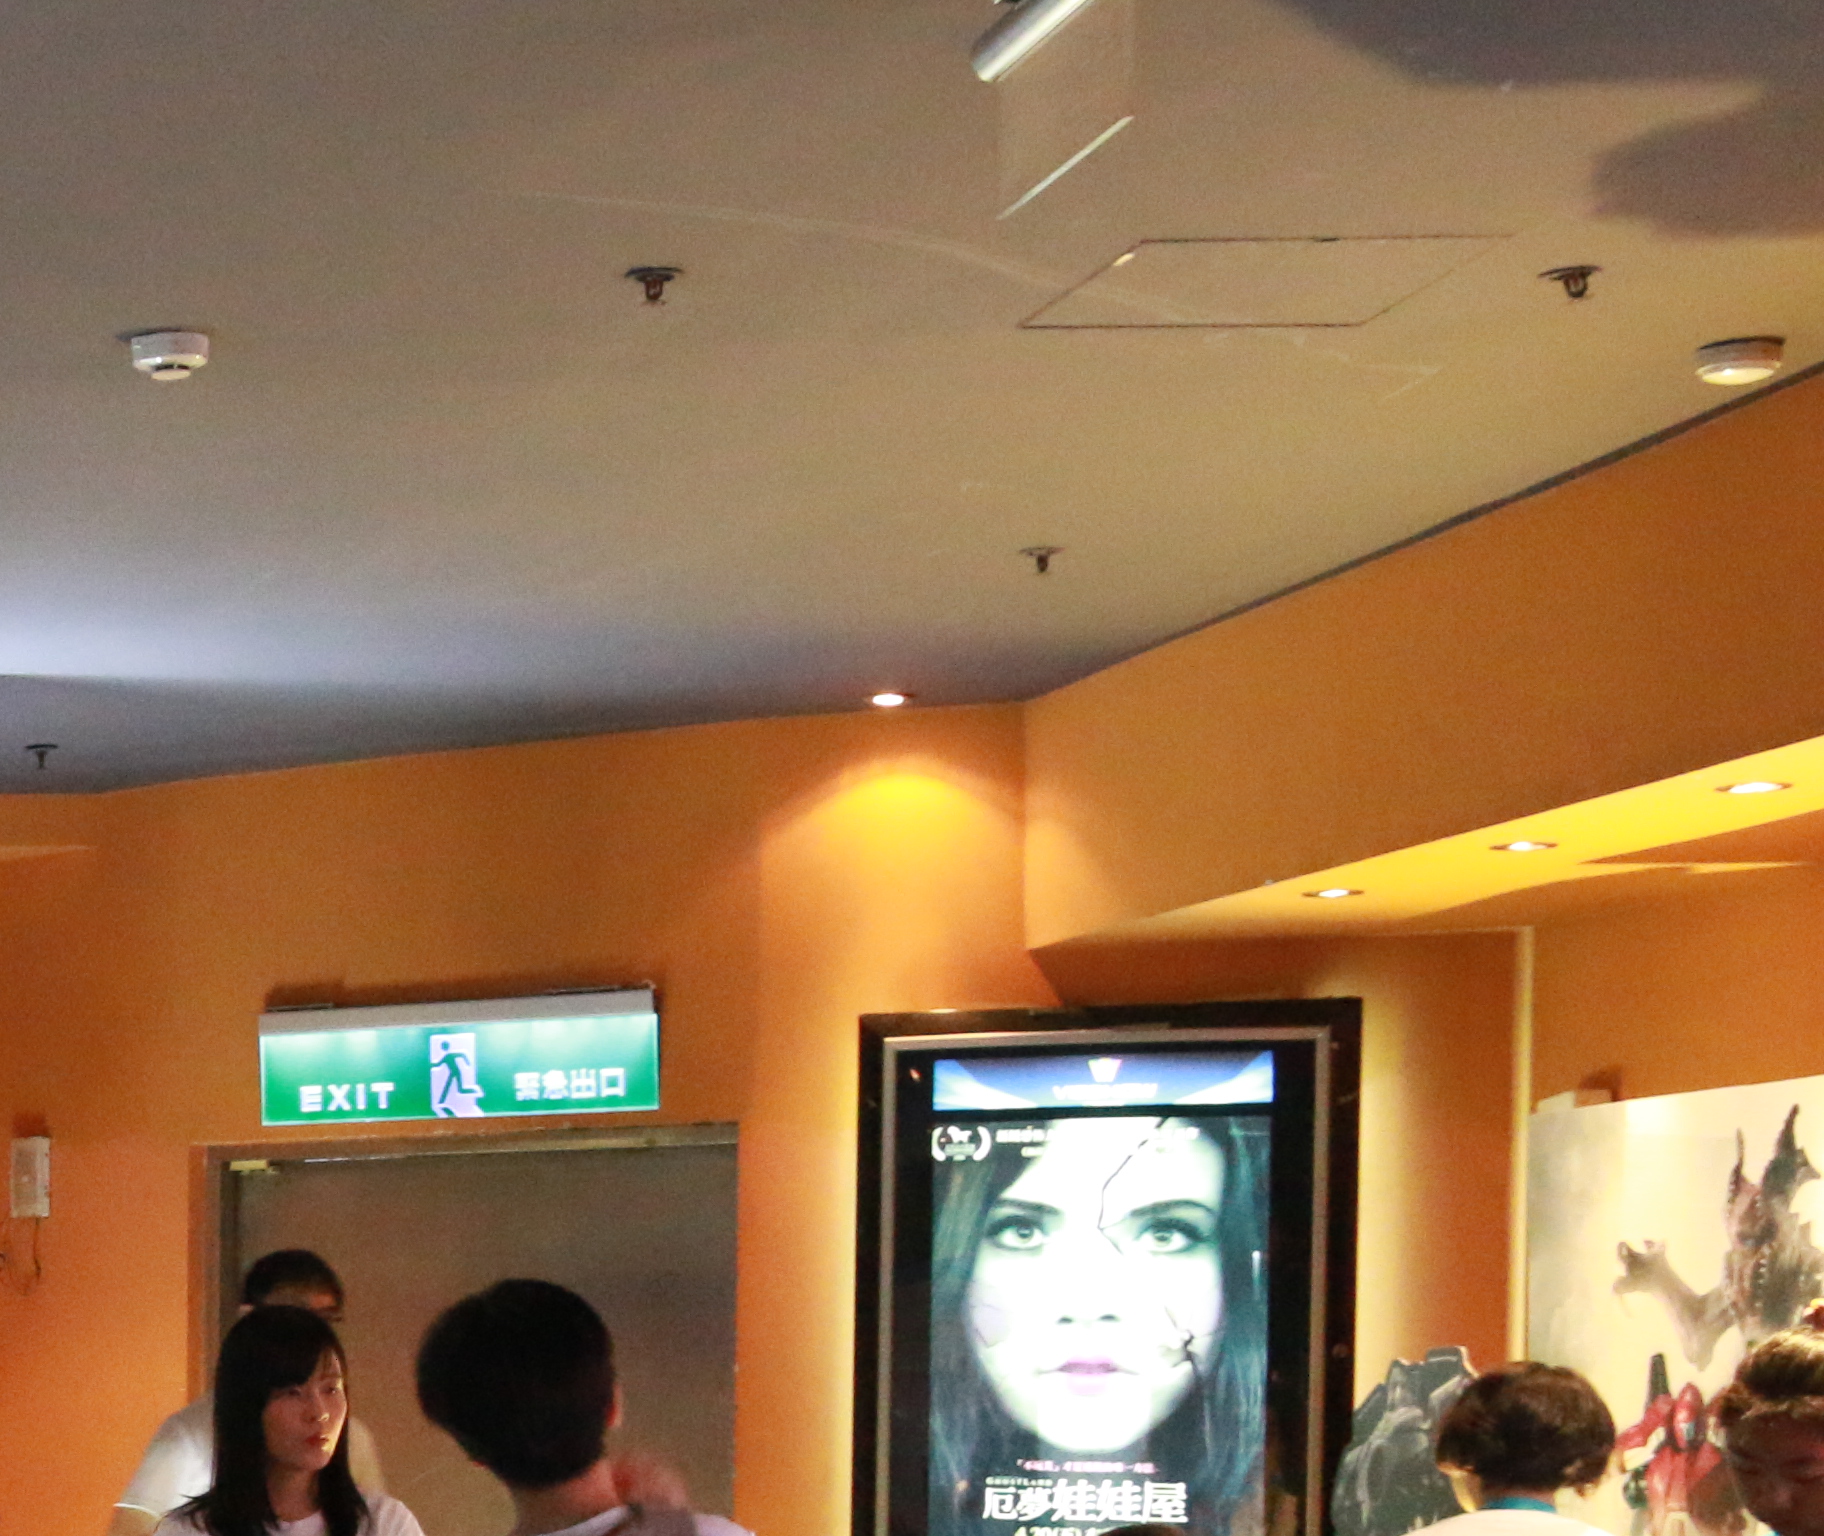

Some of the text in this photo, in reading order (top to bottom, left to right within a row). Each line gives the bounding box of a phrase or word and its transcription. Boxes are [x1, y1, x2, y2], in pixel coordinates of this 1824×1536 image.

[299, 1082, 395, 1112] EXIT
[513, 1067, 627, 1100] 緊急出口
[982, 1479, 1189, 1524] 厄夢娃娃屋
